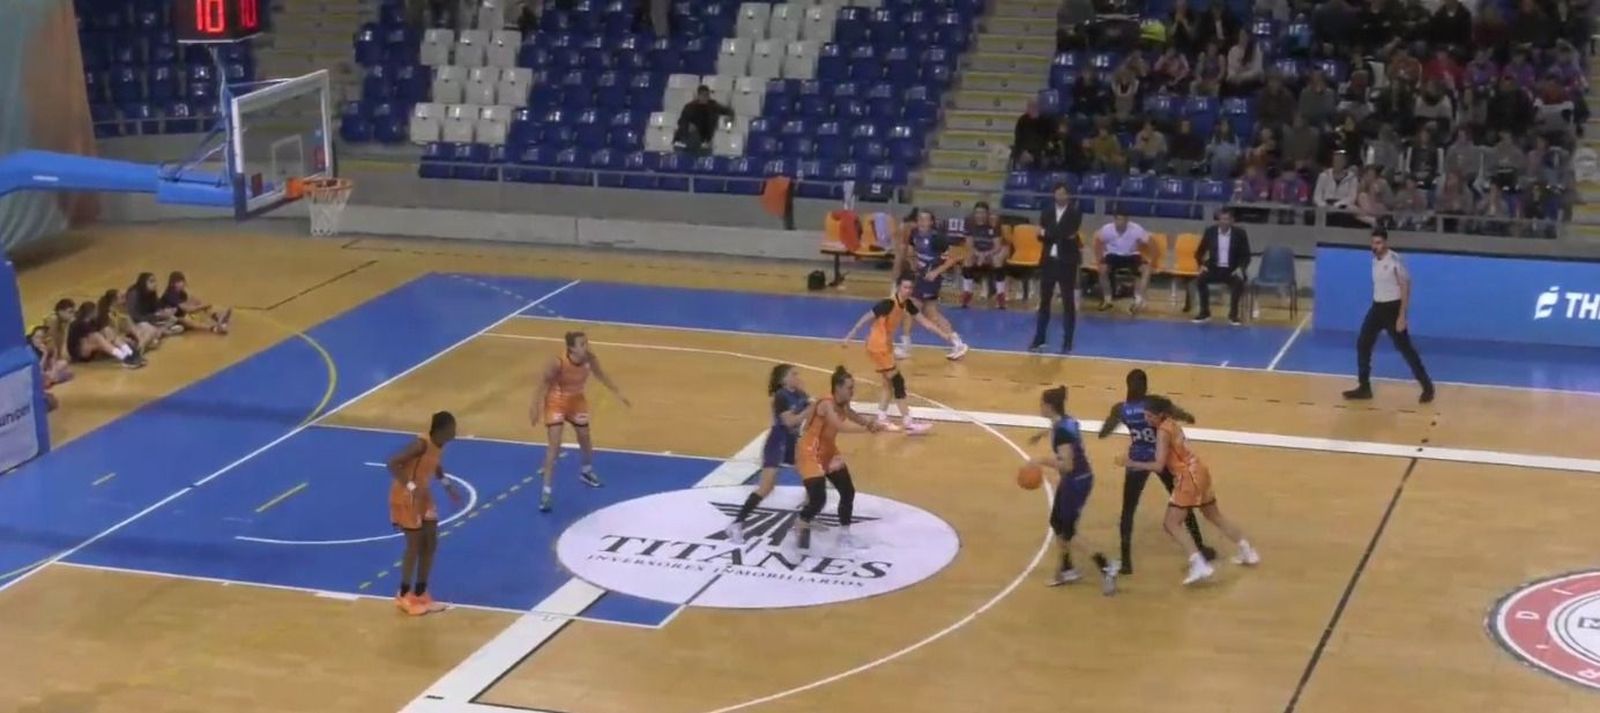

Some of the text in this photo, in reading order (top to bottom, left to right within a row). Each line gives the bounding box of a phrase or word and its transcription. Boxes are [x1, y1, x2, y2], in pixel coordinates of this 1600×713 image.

[1565, 291, 1600, 320] TH
[588, 554, 704, 572] INVERSORES
[598, 534, 893, 579] TITANES
[713, 565, 865, 588] INMOBILIARIOS
